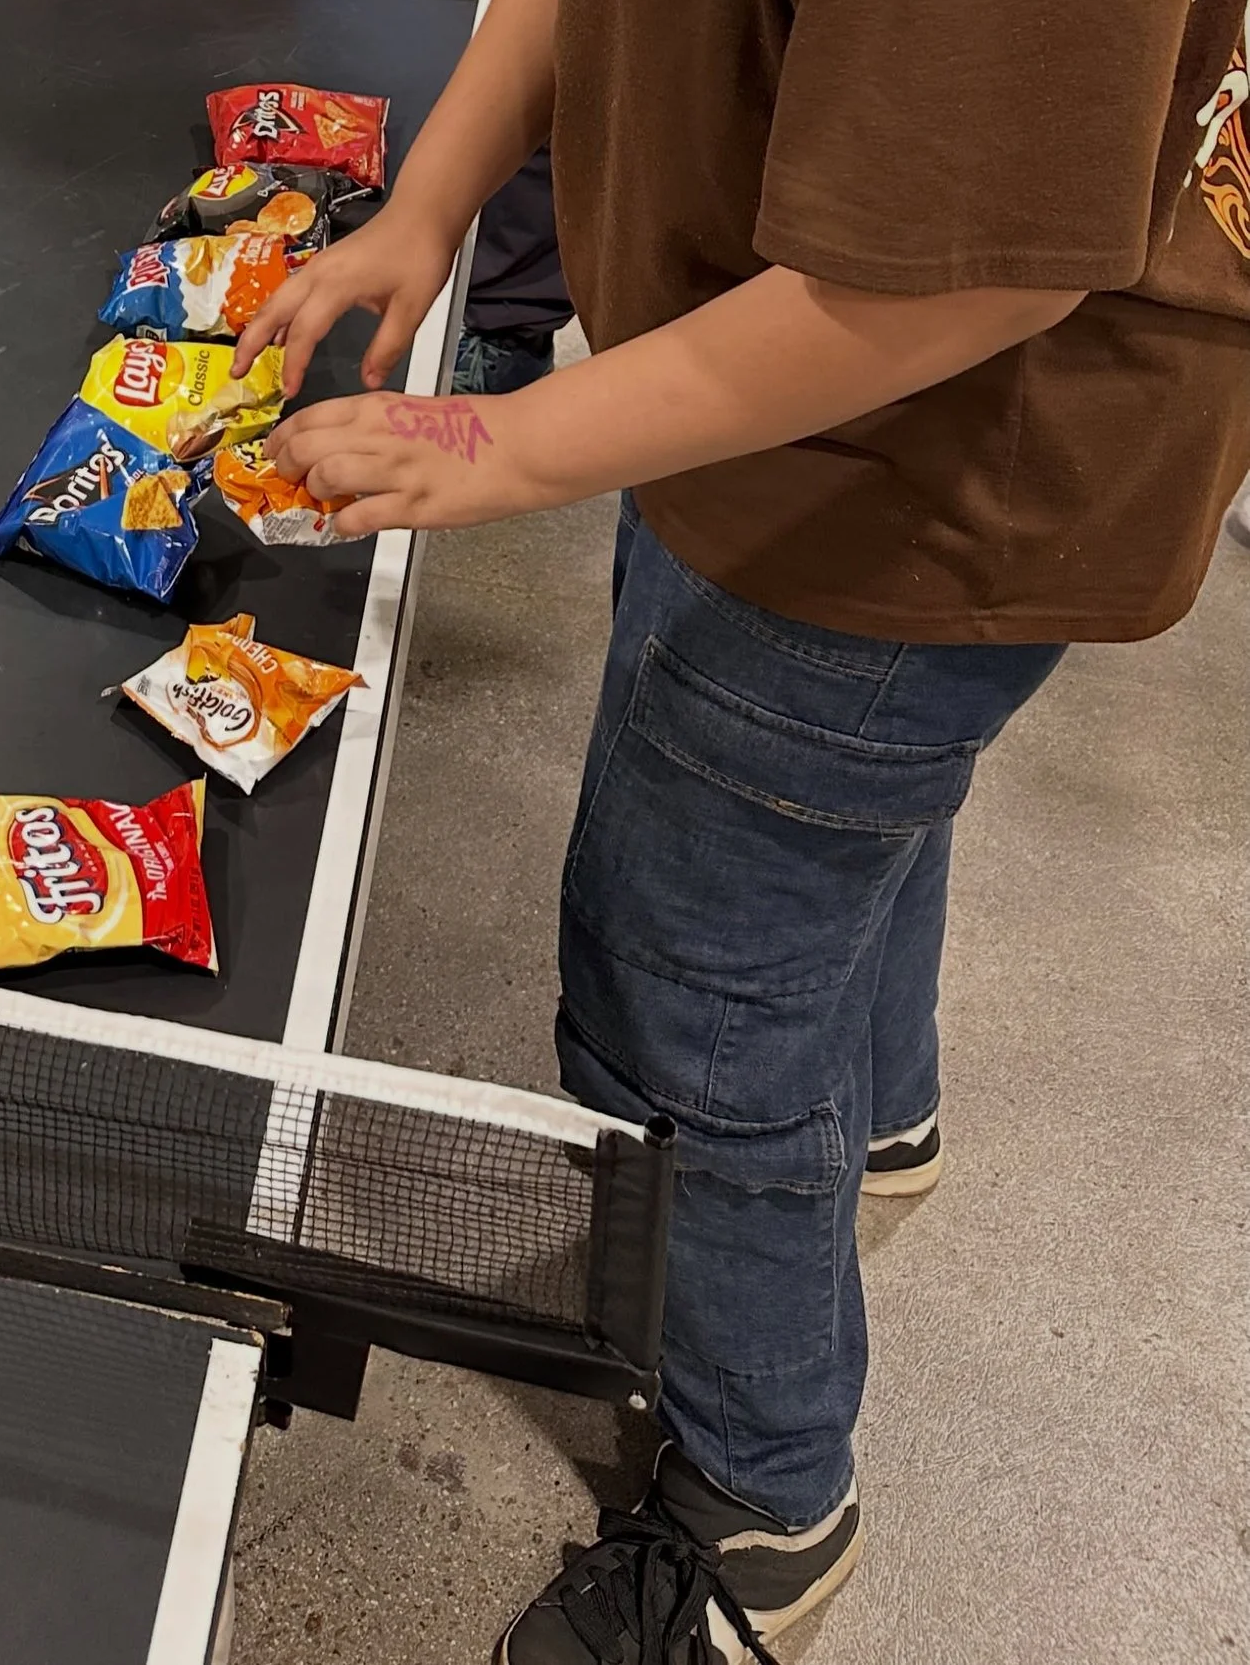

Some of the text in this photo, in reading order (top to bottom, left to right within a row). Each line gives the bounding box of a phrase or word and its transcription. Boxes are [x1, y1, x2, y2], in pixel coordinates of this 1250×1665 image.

[115, 338, 167, 403] Lay's
[187, 349, 211, 407] Classic
[28, 441, 126, 524] Doritos
[172, 682, 251, 732] Goldfish
[16, 805, 104, 924] Fritos
